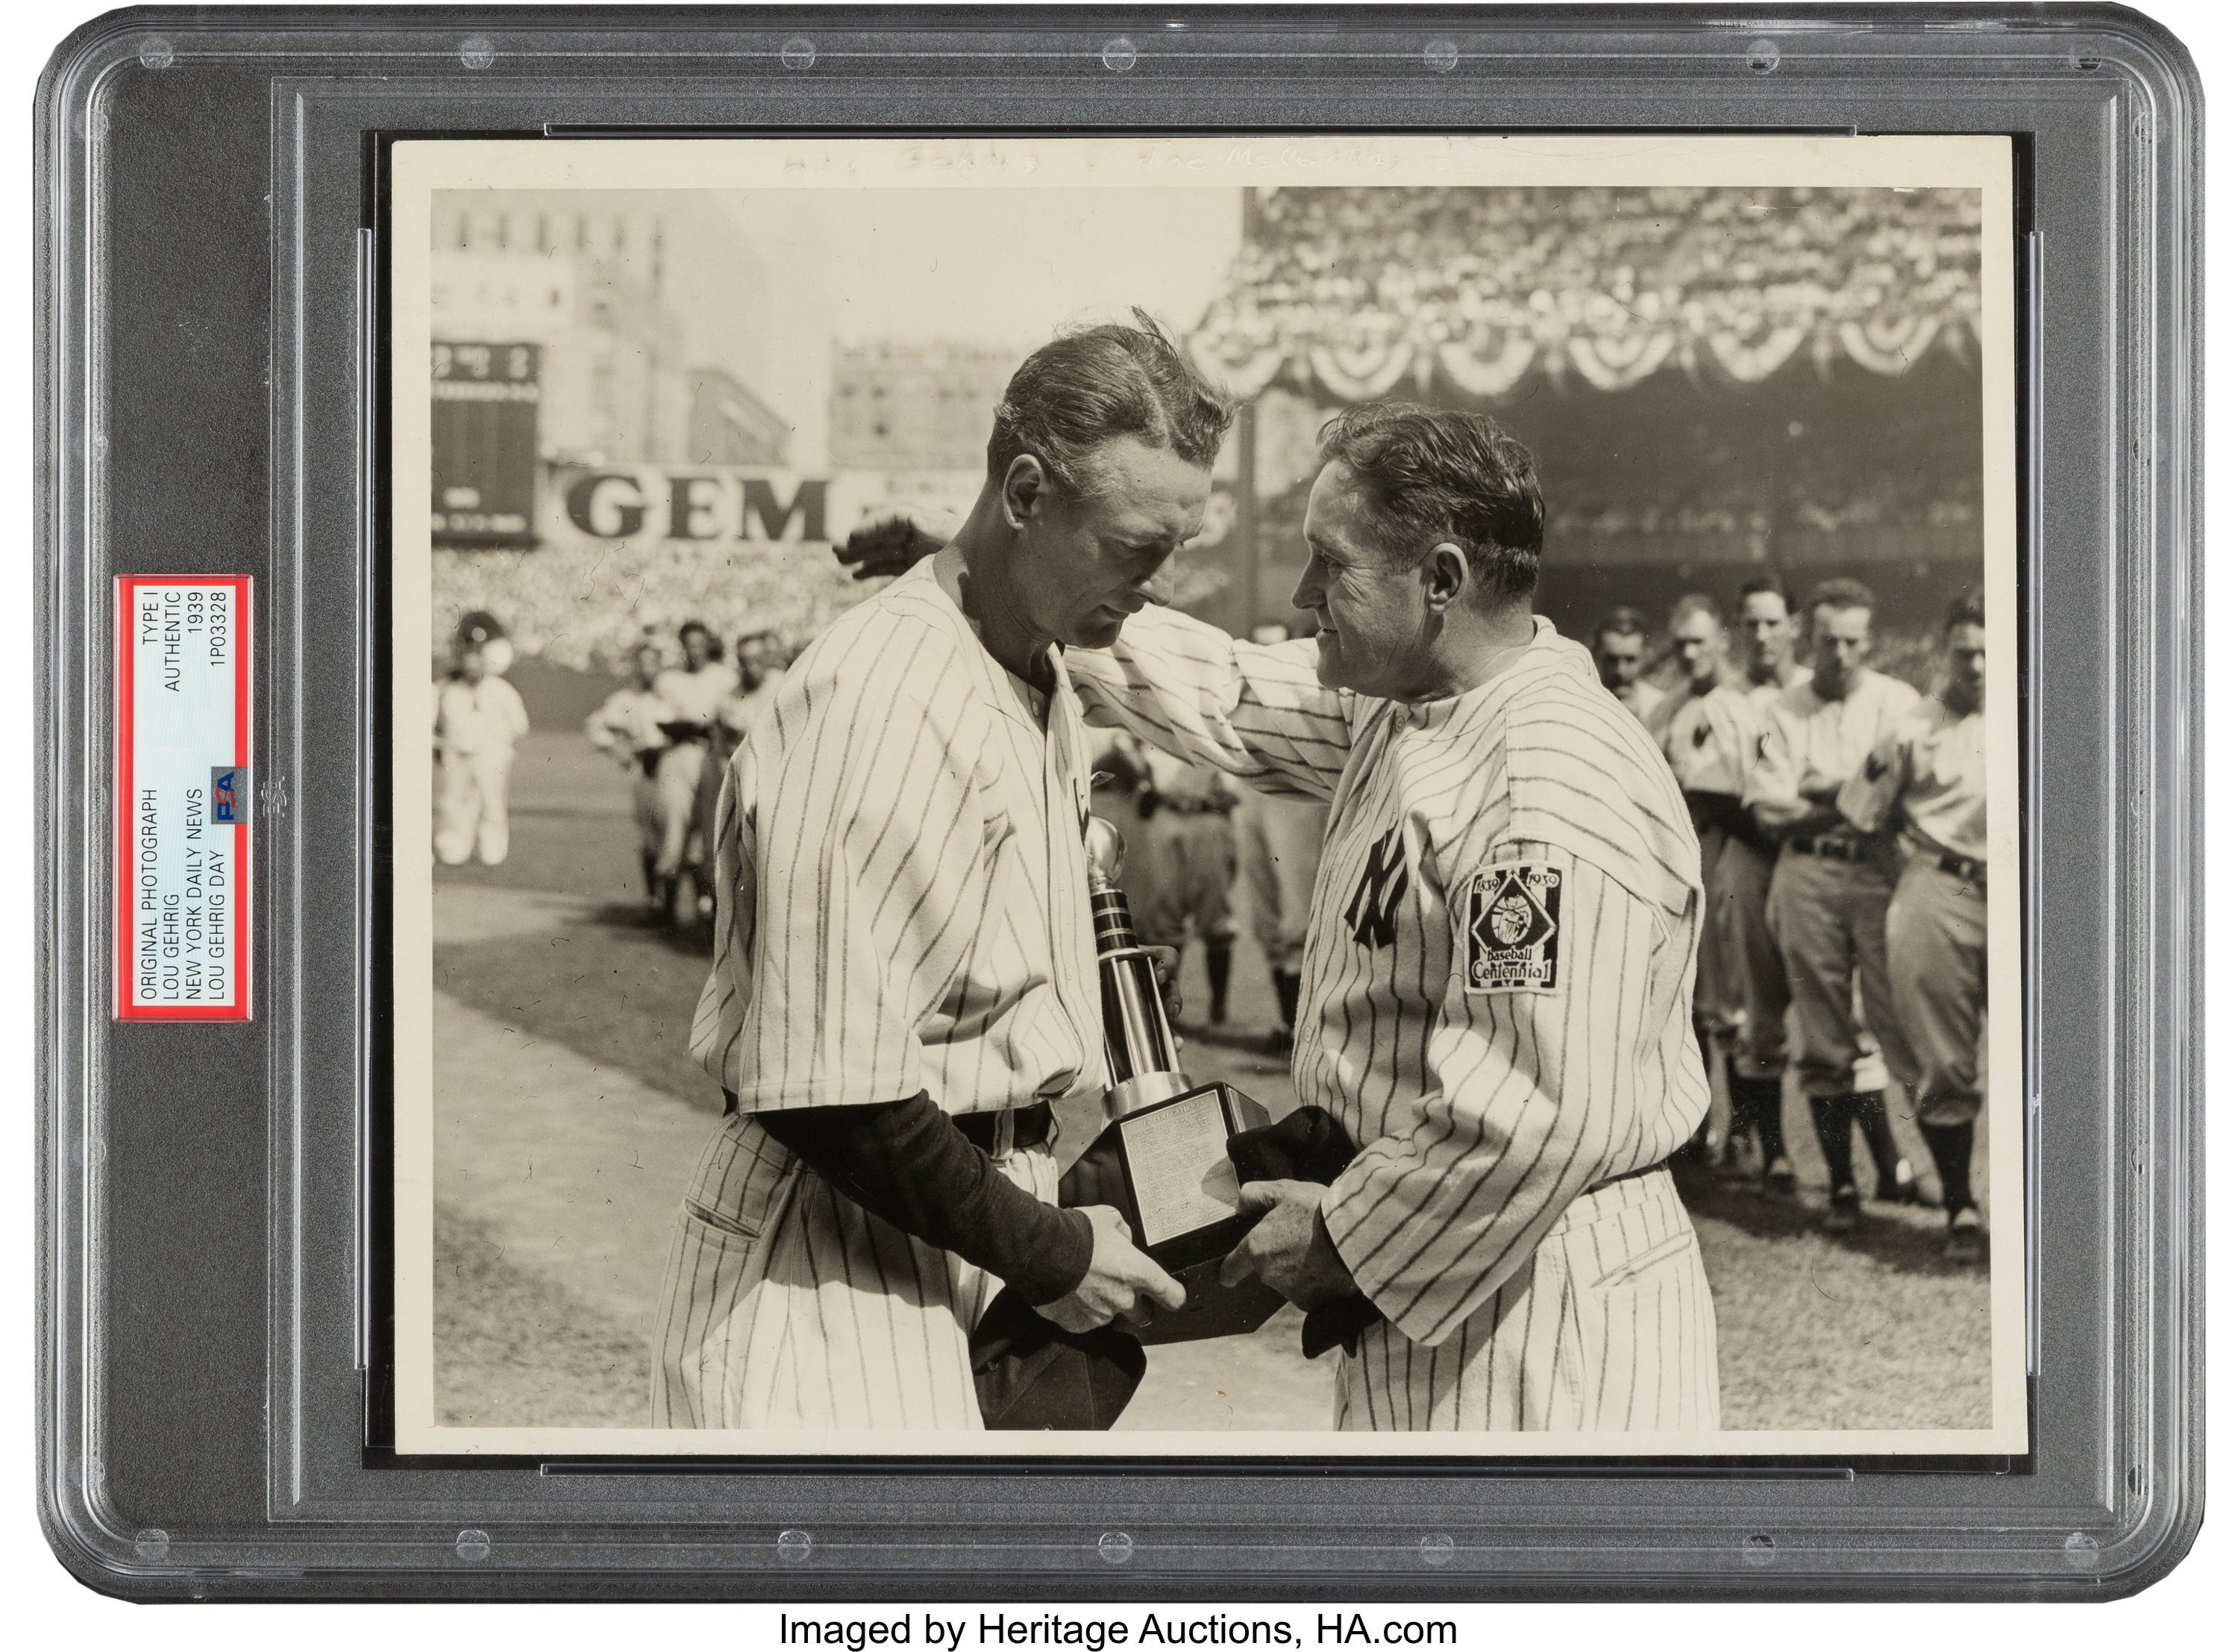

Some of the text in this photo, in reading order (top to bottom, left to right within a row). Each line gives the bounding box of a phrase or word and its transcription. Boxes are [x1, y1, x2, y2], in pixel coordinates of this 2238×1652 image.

[566, 474, 830, 541] GEM
[142, 602, 158, 645] TYPE
[164, 591, 181, 692] AUTHENTIC
[187, 591, 203, 634] 1939
[210, 591, 226, 667] 1P03328
[216, 771, 236, 820] PSA
[141, 789, 157, 1000] ORIGINAL PHOTOGRAPH
[186, 788, 202, 1000] NEW YORK DAILY NEWS
[1475, 873, 1558, 893] 1839 1939
[163, 893, 179, 1000] LOU GEHRIG
[209, 850, 225, 1000] LOU GEHRIG DAY
[1473, 959, 1549, 980] Centennial
[1153, 1112, 1169, 1123] LOU
[1170, 1102, 1200, 1117] GEHRIG
